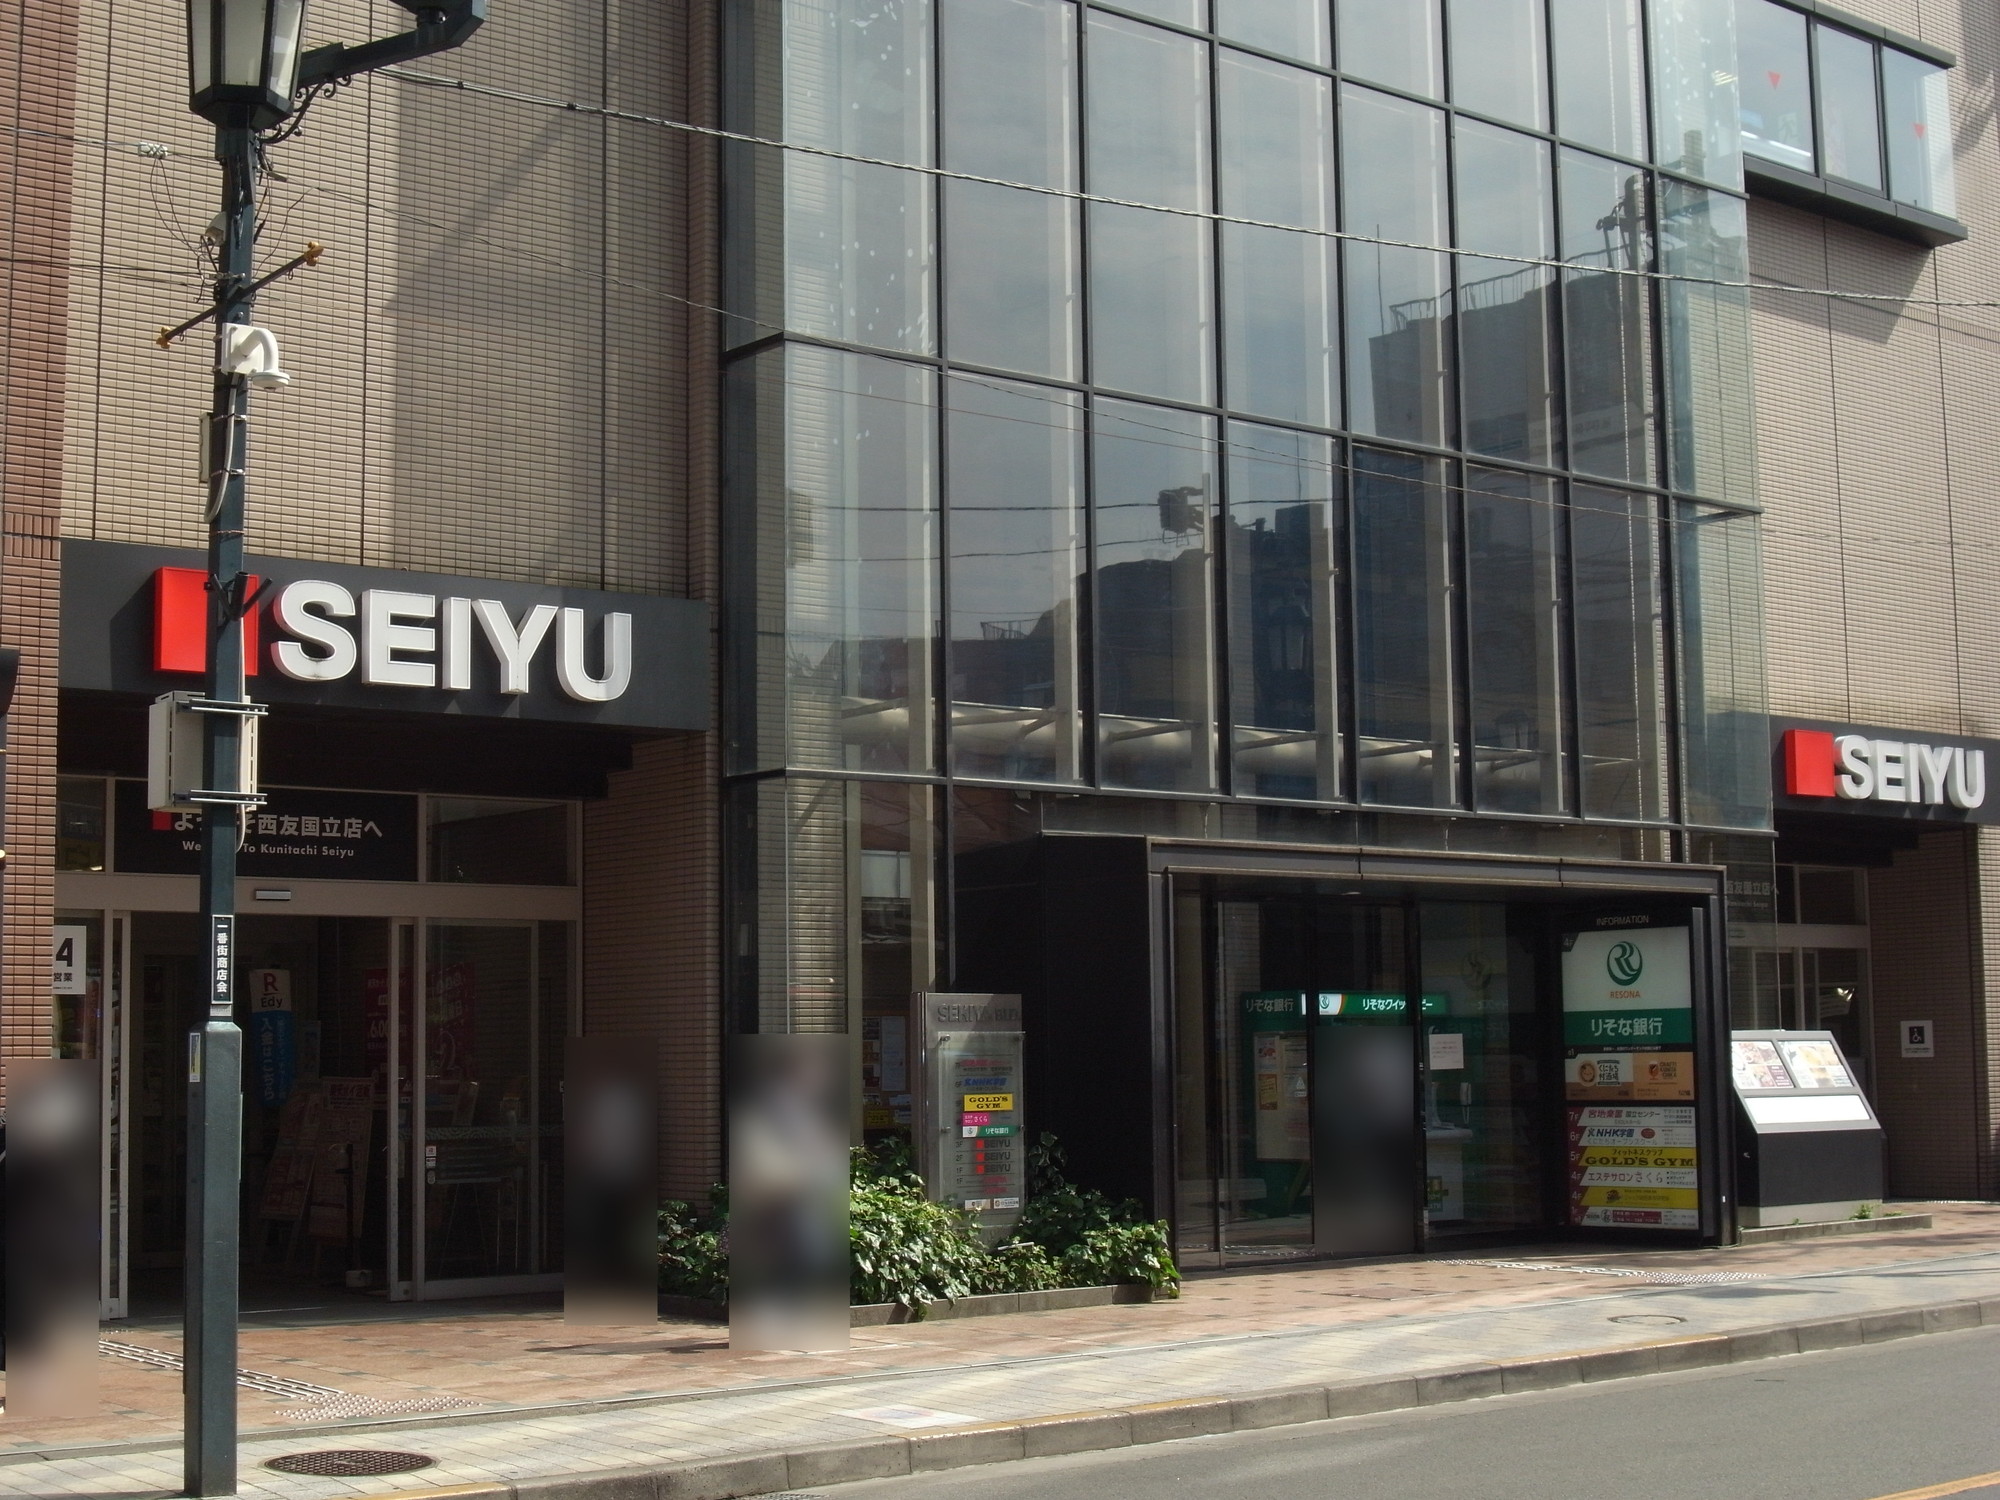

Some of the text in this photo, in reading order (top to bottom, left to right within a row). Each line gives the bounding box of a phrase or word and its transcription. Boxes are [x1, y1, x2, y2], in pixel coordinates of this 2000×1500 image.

[271, 579, 633, 702] SEIYU
[1833, 732, 1986, 810] SEIYU
[243, 841, 355, 860] To Kunitachi Seiyu
[1596, 915, 1649, 926] INFORMATION
[216, 924, 229, 993] 一番街商店会
[1609, 991, 1641, 999] RESONA
[261, 997, 283, 1009] Edy
[1245, 998, 1294, 1013] りそな銀行
[1591, 1017, 1663, 1037] りそな銀行
[973, 1115, 988, 1123] さくら
[1569, 1111, 1579, 1120] 7F
[1569, 1131, 1580, 1141] 6F
[984, 1151, 1011, 1161] SEIYU
[1570, 1151, 1581, 1161] 5F
[1612, 1148, 1663, 1157] フィットネスクラブ
[1585, 1156, 1694, 1167] GOLD'S GYM
[984, 1164, 1011, 1173] SEIYU
[1571, 1171, 1582, 1181] 4F
[1571, 1190, 1582, 1200] 4F
